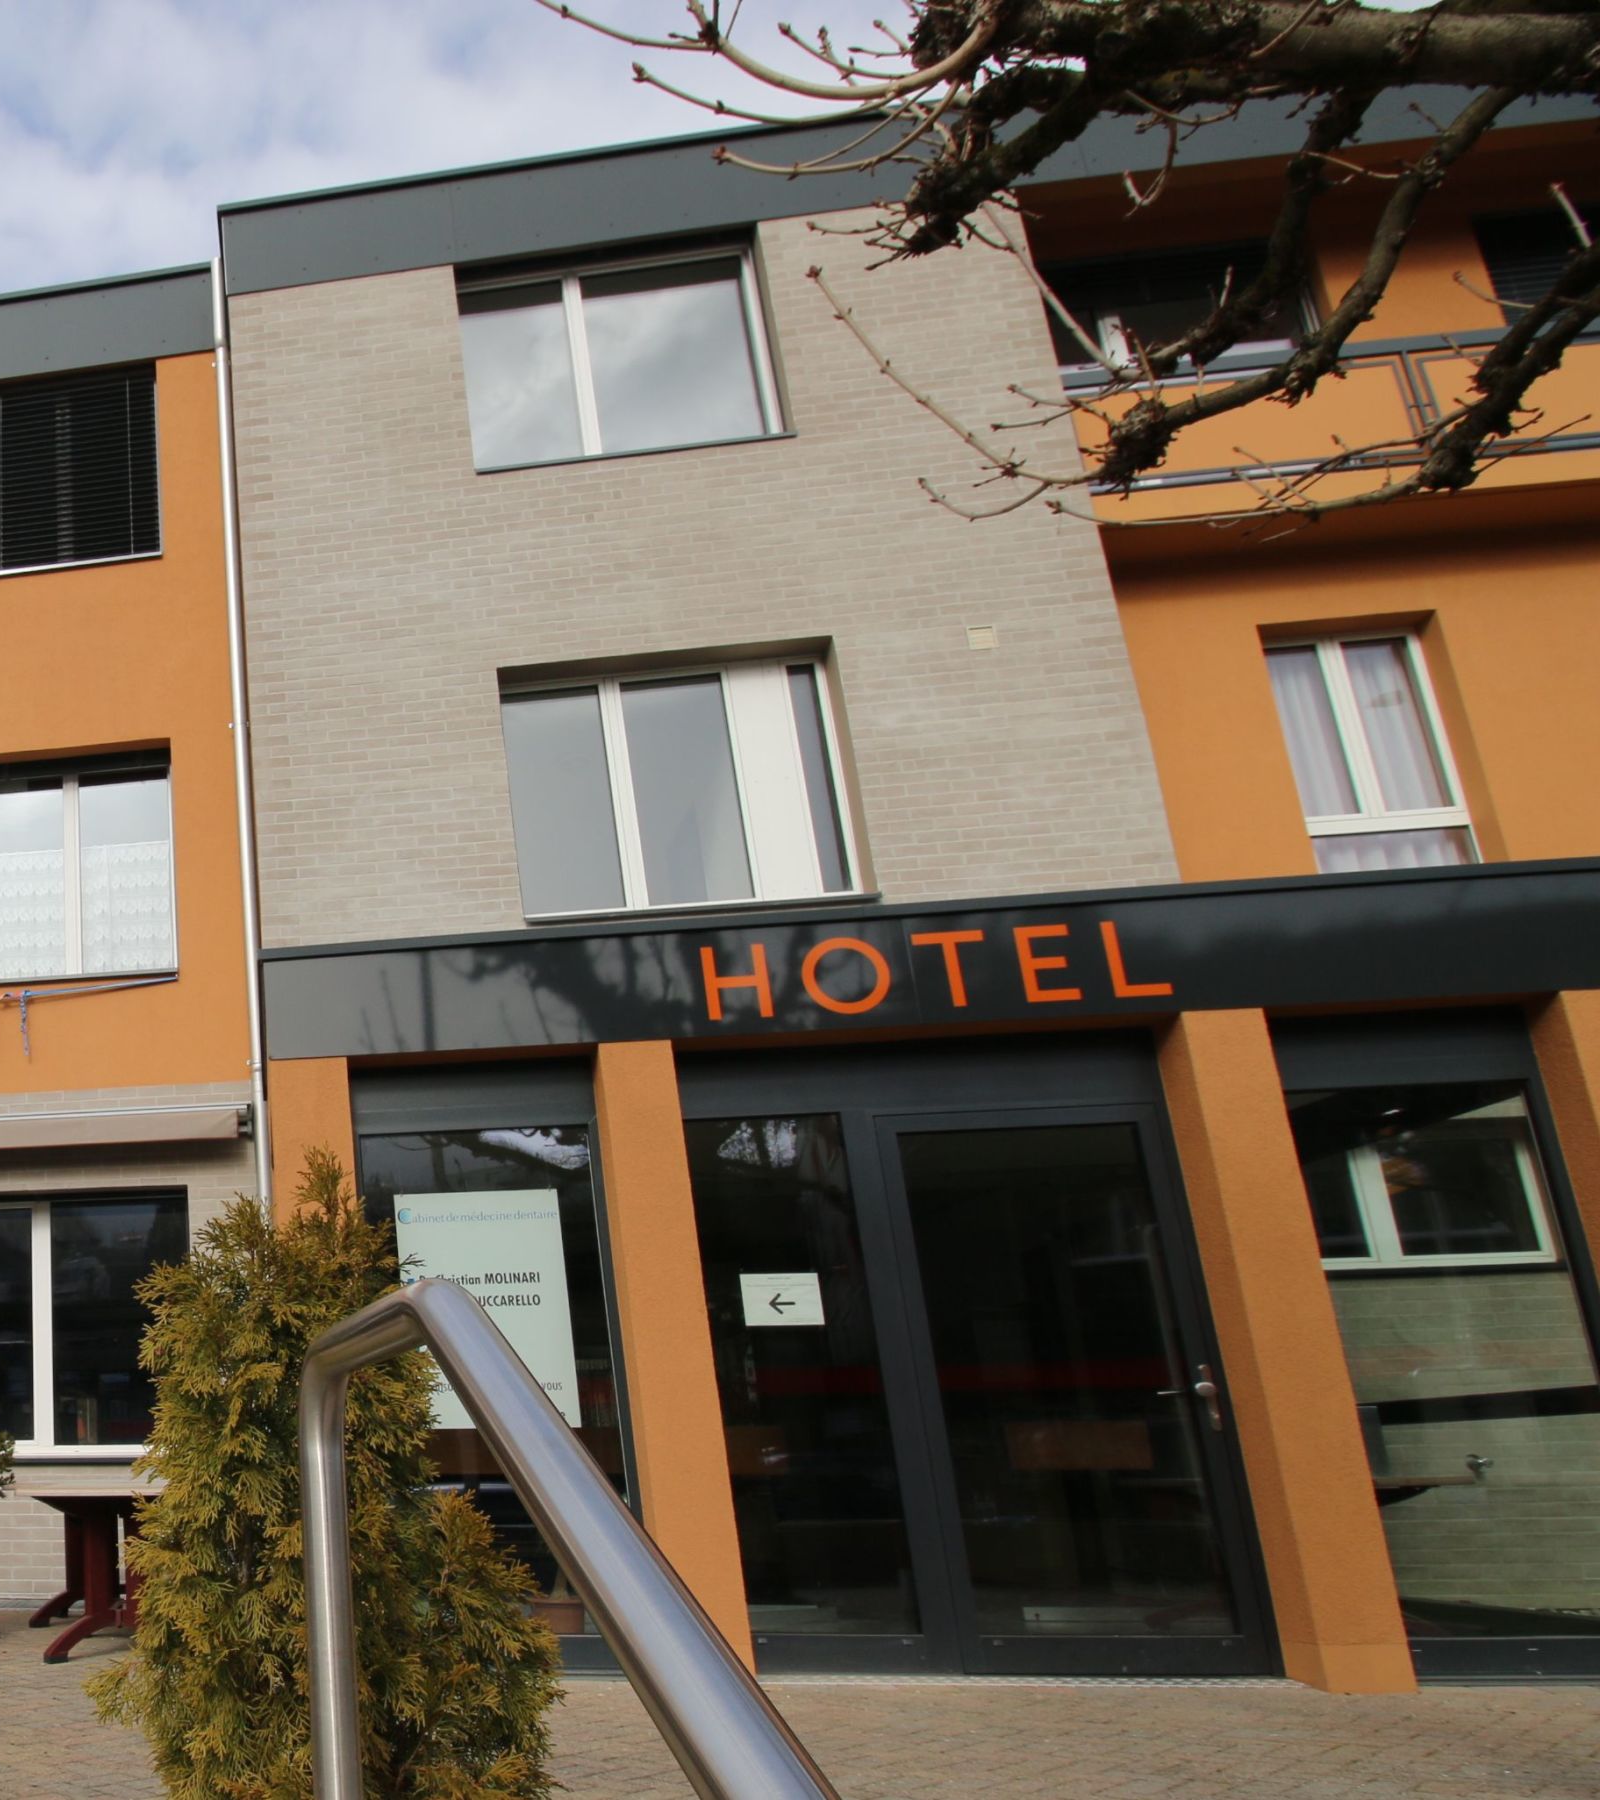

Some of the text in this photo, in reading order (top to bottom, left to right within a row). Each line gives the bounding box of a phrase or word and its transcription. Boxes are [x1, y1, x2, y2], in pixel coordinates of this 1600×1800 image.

[700, 920, 1173, 1021] HOTEL
[397, 1208, 558, 1224] Cabinet de médecine dentaire
[484, 1272, 541, 1285] MOLINARI
